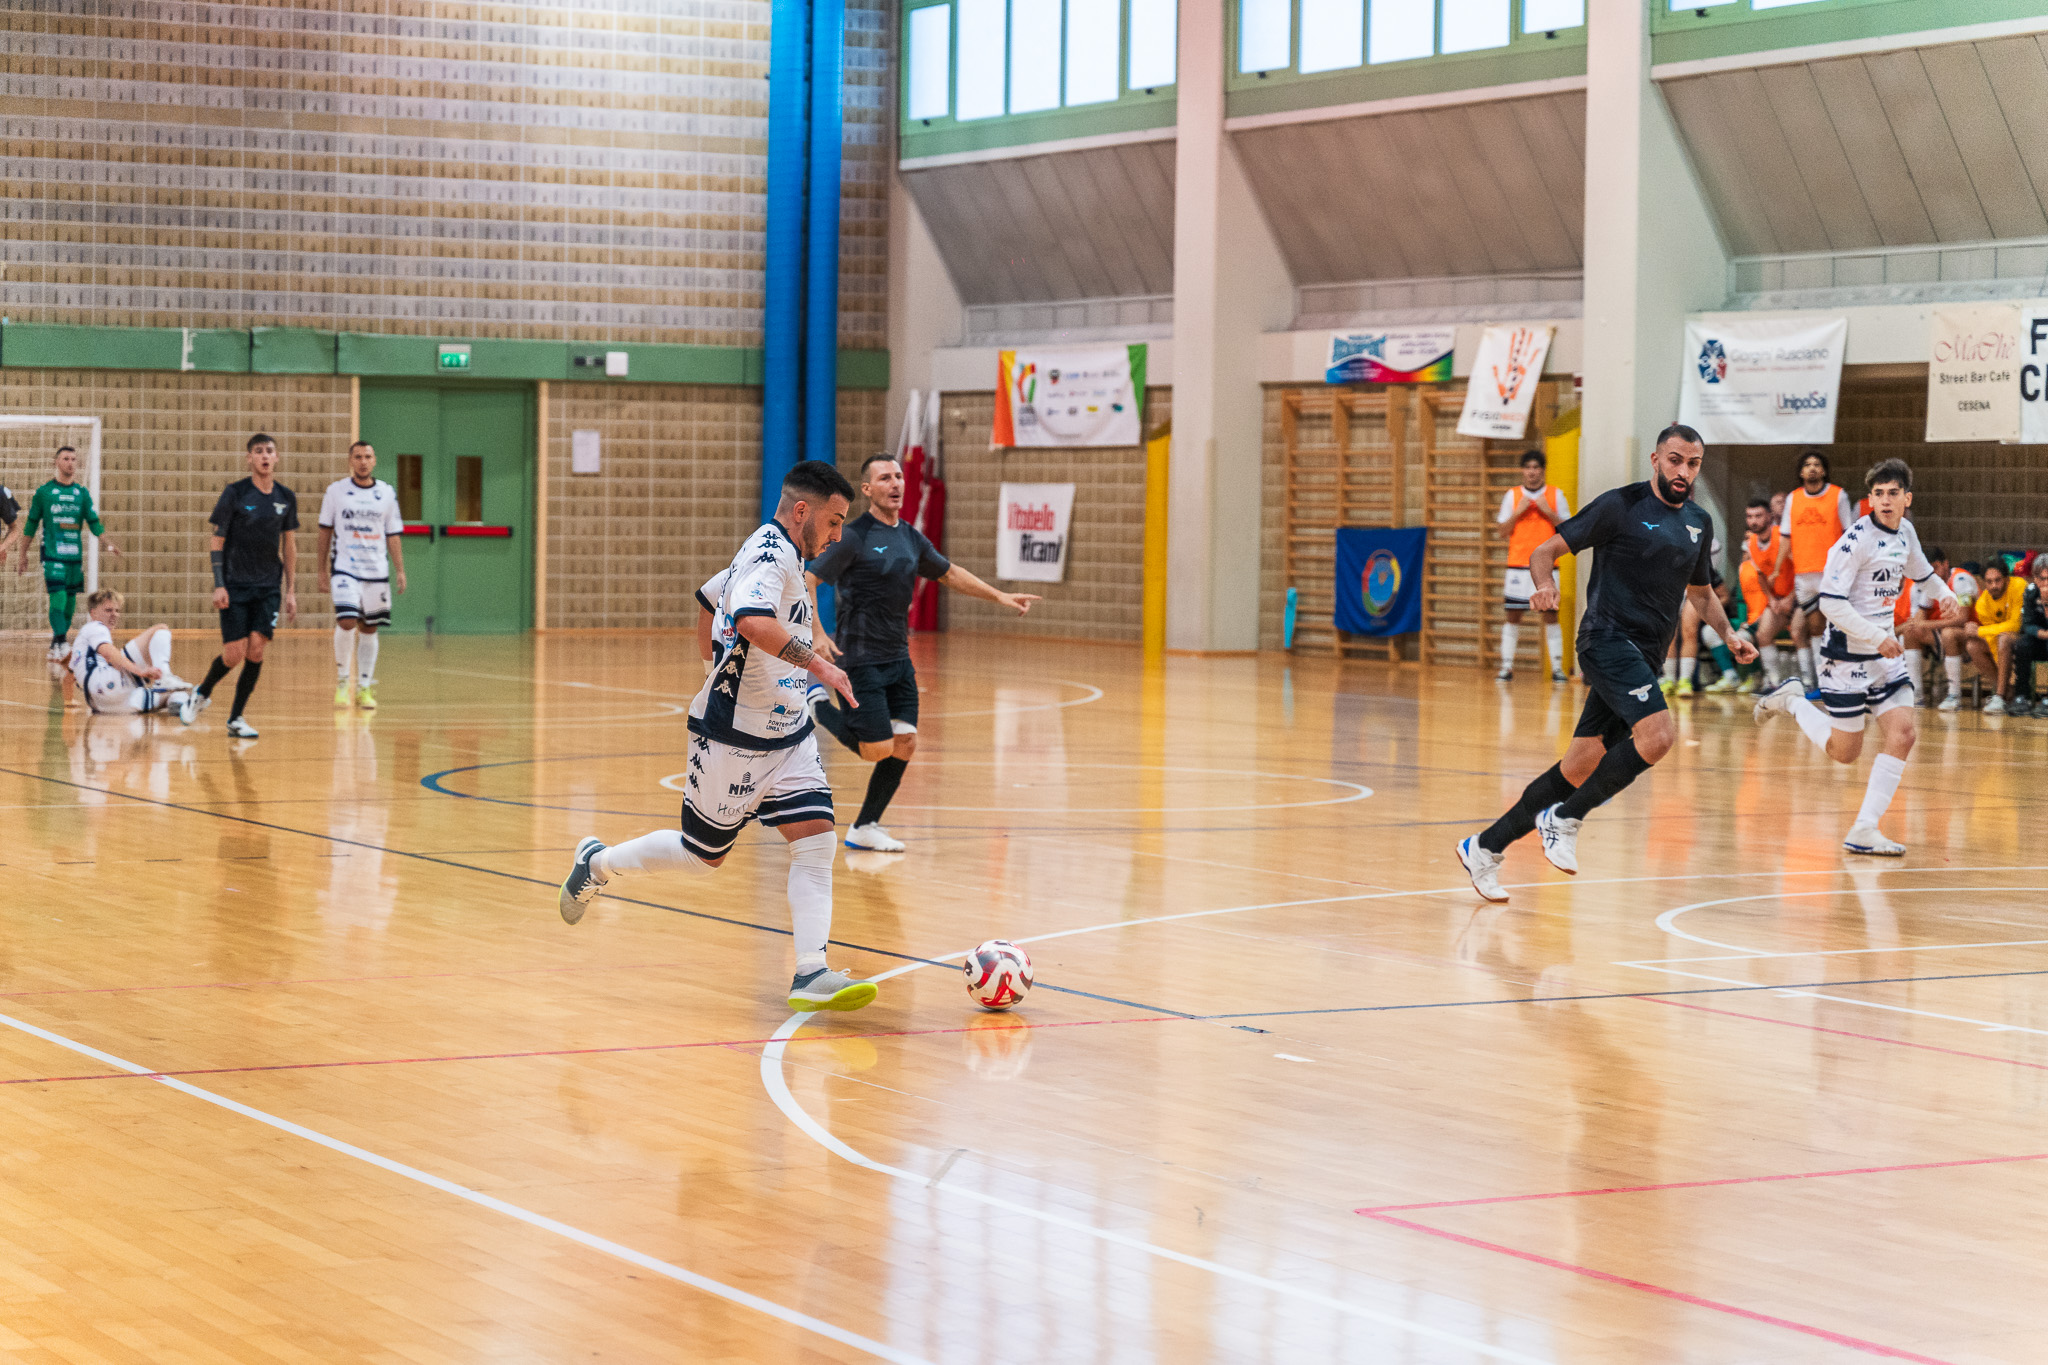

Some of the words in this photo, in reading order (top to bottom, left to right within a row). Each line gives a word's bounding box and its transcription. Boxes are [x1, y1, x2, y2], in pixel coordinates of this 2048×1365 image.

[1940, 372, 1968, 384] Street
[1970, 371, 1987, 383] Bar
[1957, 400, 1991, 412] CESENA
